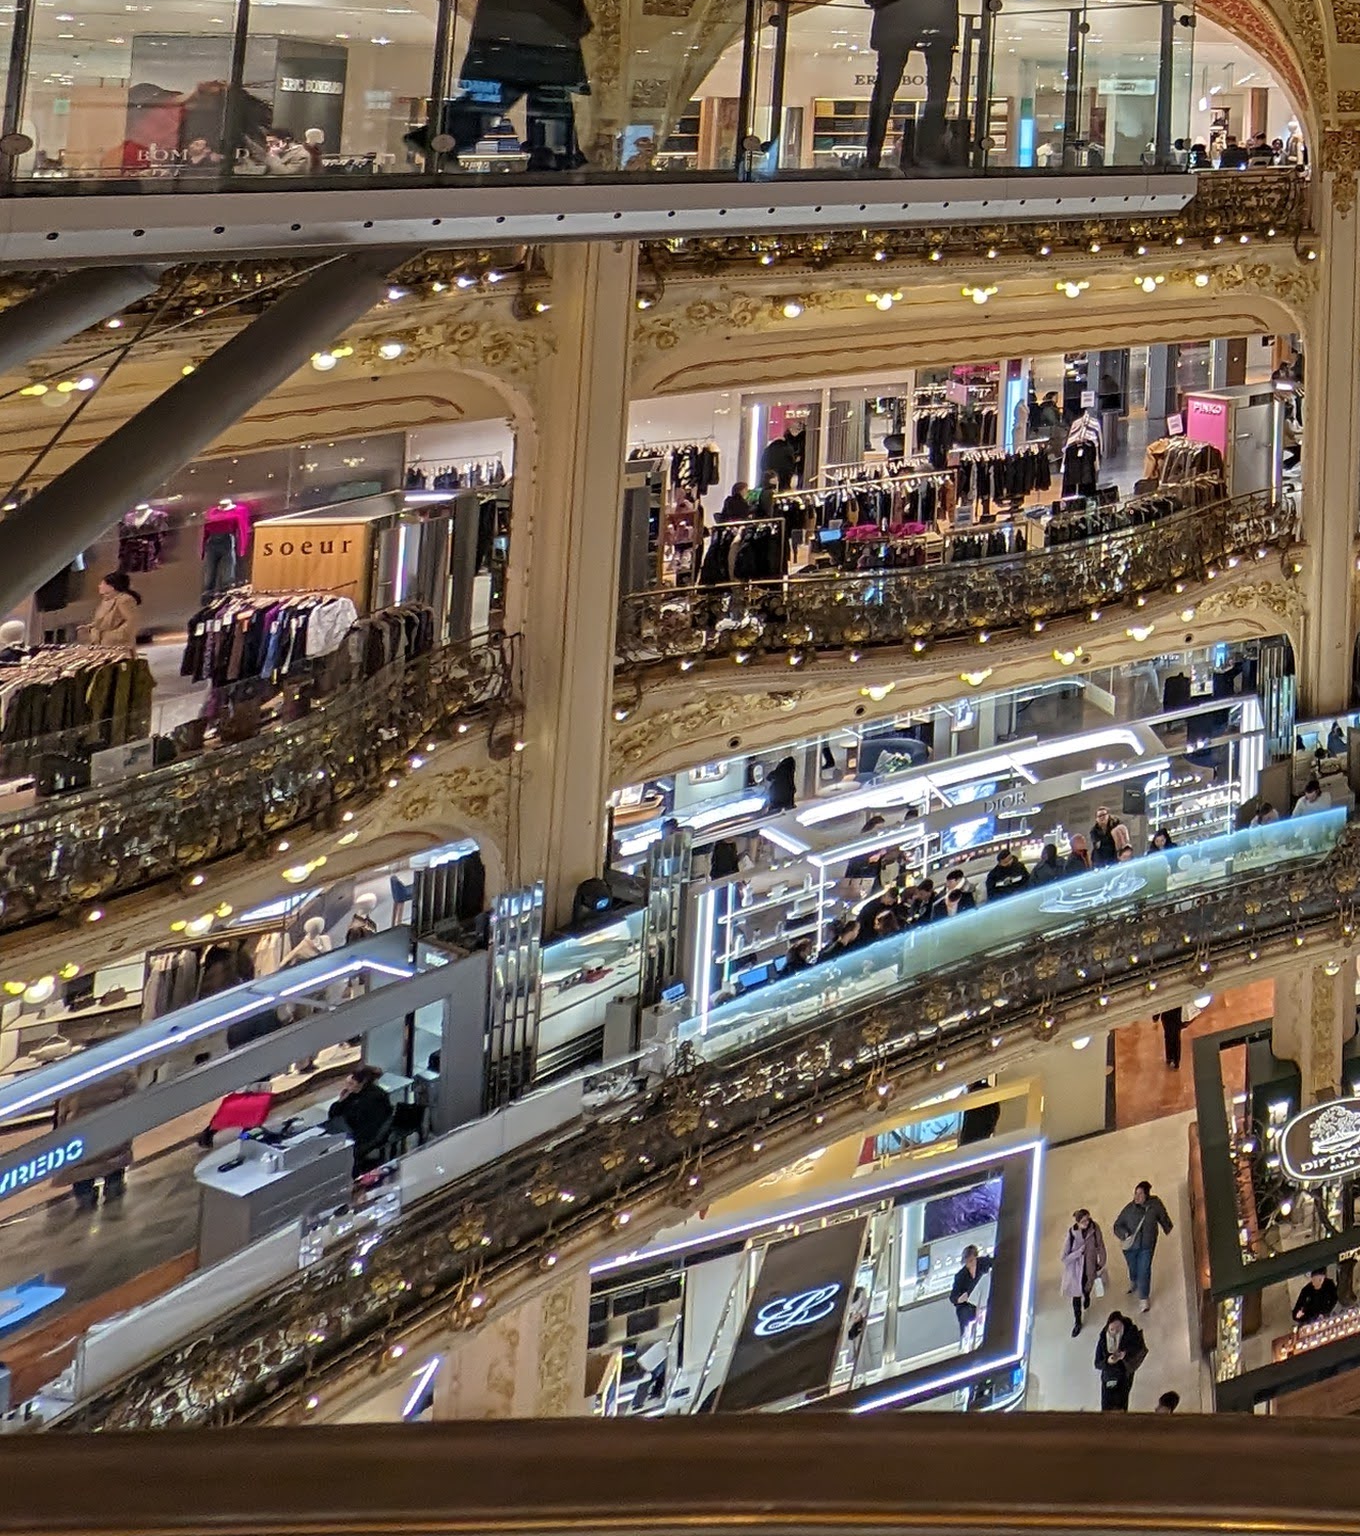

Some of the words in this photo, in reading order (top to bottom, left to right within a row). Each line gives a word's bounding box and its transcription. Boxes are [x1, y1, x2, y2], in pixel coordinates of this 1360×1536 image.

[263, 540, 352, 557] soeur
[983, 790, 1028, 814] DIOR
[1330, 1160, 1355, 1171] PARIS
